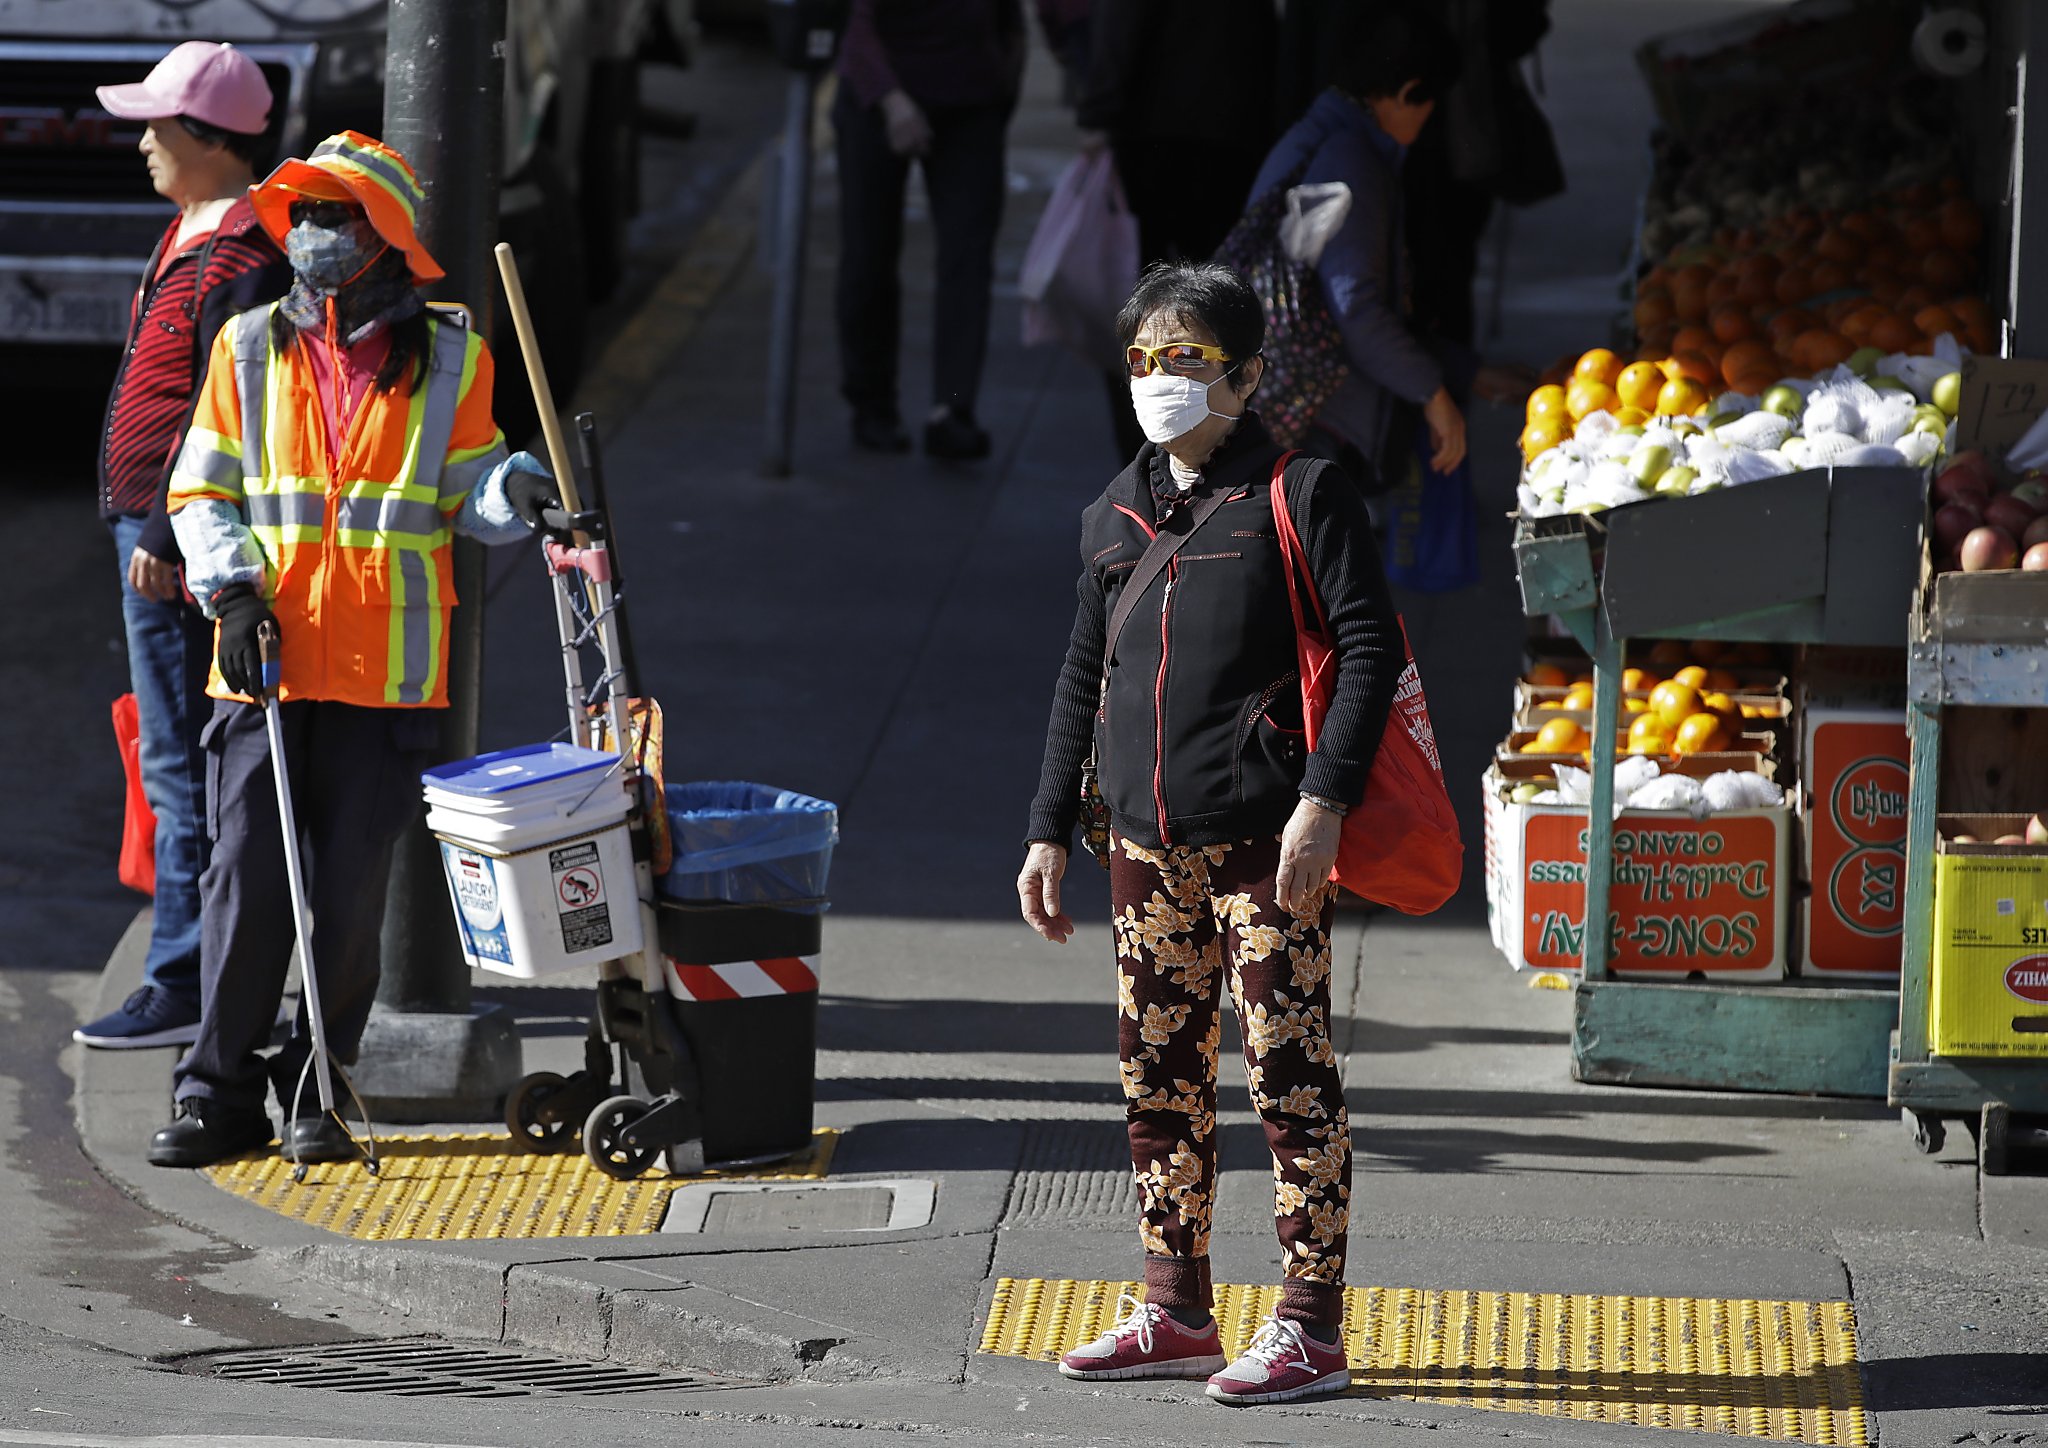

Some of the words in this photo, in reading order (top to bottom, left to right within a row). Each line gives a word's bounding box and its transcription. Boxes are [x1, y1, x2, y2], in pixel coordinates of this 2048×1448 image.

[1577, 829, 1724, 857] ORANGS
[1529, 856, 1674, 904] Hapness
[1631, 912, 1760, 959] SONG
[2022, 928, 2048, 943] LES
